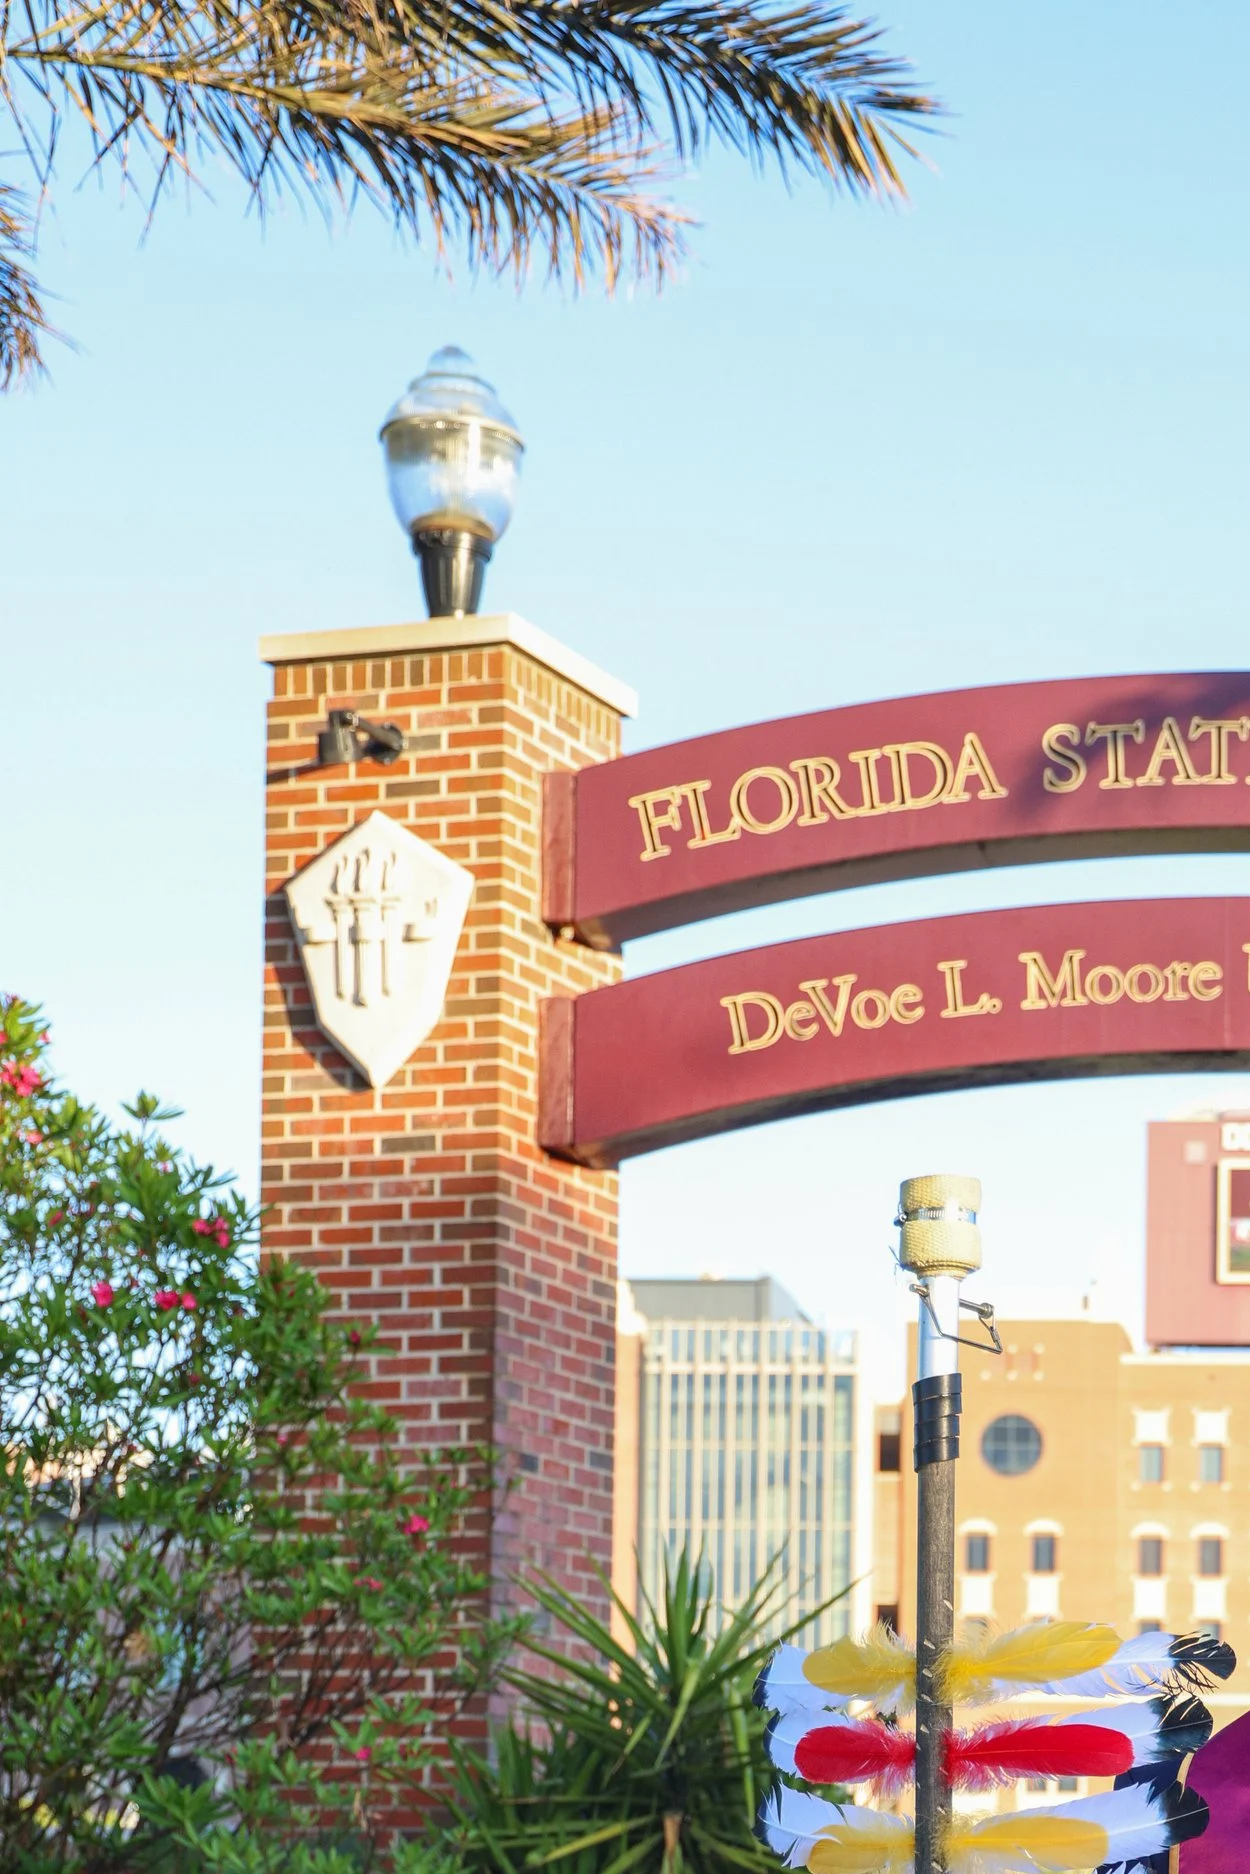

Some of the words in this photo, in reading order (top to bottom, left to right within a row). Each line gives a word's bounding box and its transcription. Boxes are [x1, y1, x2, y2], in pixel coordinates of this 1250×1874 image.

[628, 732, 1009, 862] FLORIDA
[720, 973, 924, 1054] DeVoe
[937, 959, 1002, 1020] L.
[1018, 949, 1223, 1011] Moore
